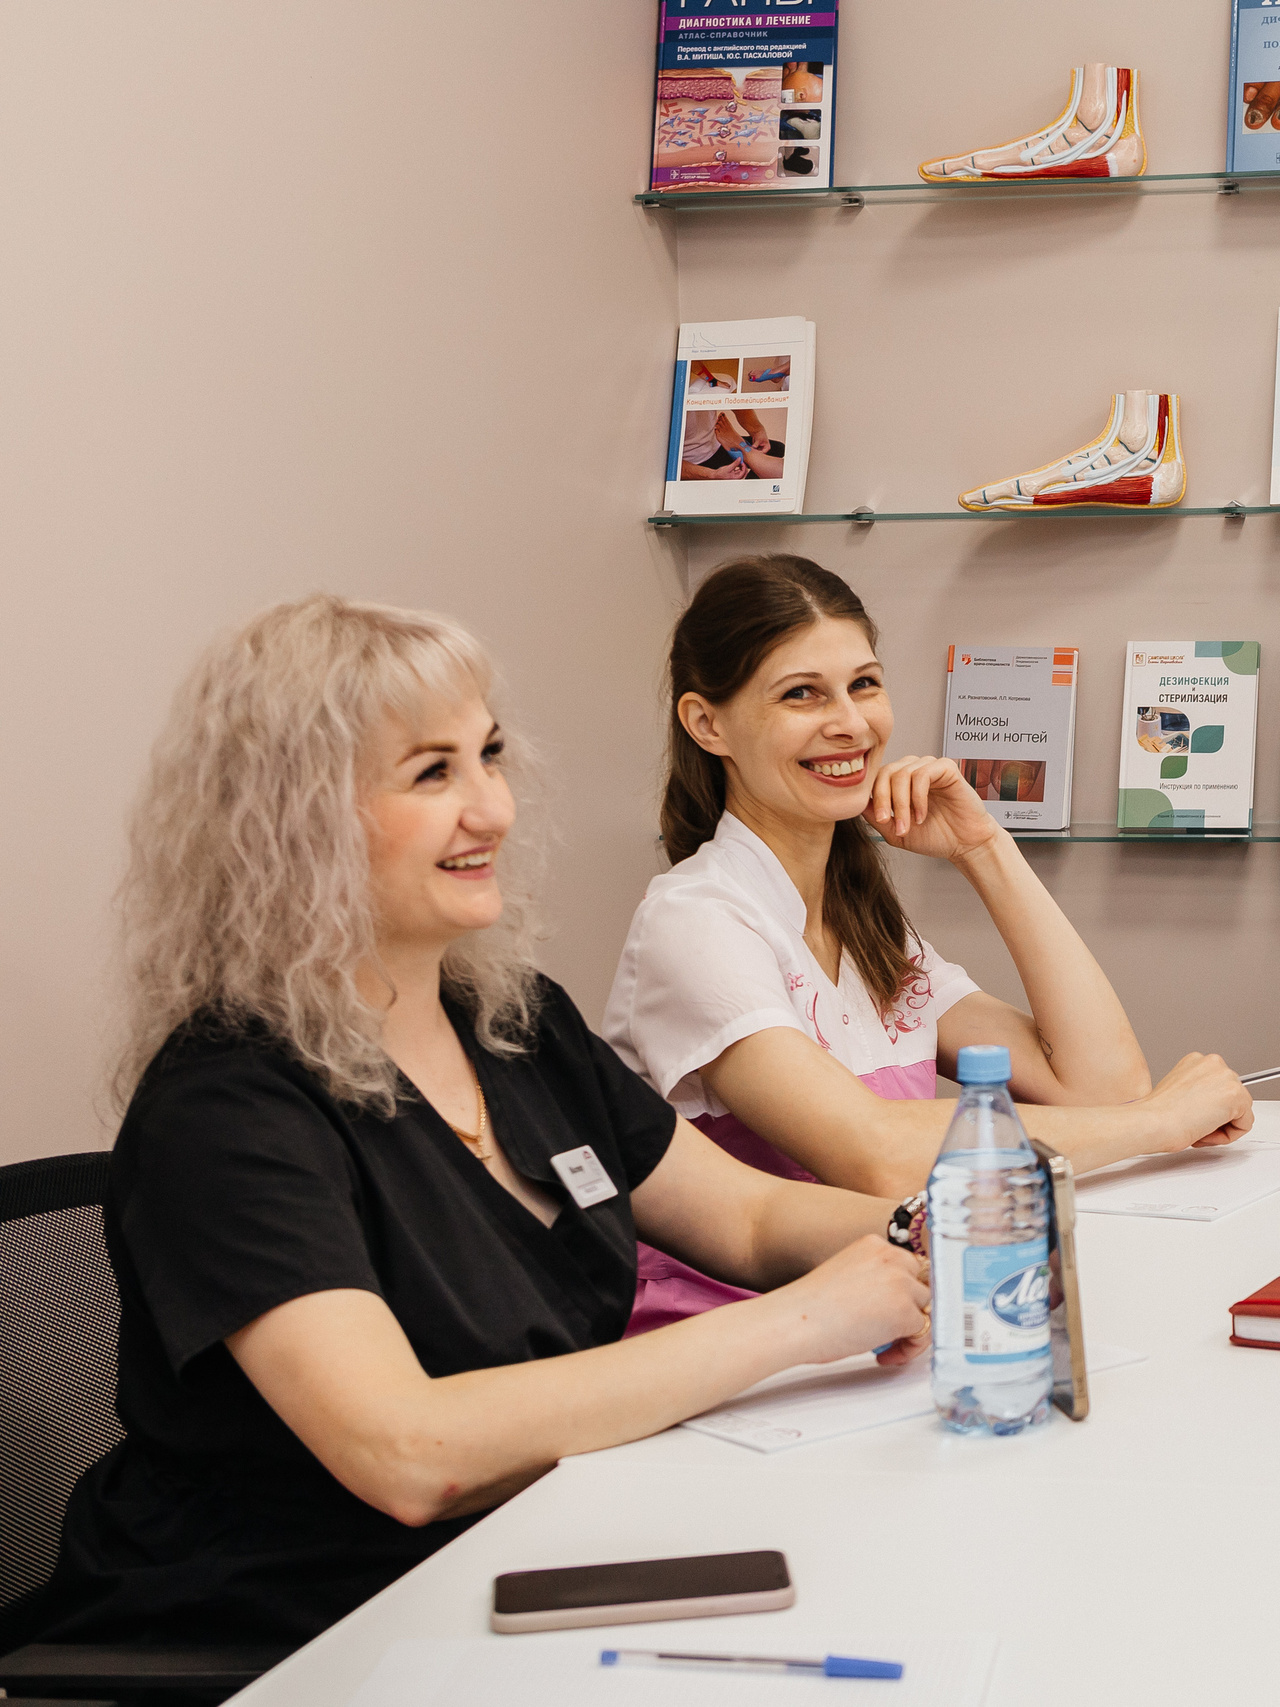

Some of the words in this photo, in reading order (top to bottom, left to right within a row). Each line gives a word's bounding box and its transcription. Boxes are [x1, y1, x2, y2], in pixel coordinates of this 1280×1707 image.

[678, 16, 752, 29] ДИАГНОСТИКА
[755, 16, 762, 26] И
[765, 15, 811, 26] ЛЕЧЕНИЕ
[678, 31, 768, 40] АТЛАС-СПРАВОЧНИК
[677, 45, 706, 53] Перевод
[769, 43, 807, 51] редакцией
[743, 51, 793, 59] ПАСХАЛОВОЙ
[686, 398, 722, 406] Концепция
[1159, 676, 1229, 686] ДЕЗИНФЕКЦИЯ
[1158, 693, 1228, 704] СТЕРИЛИЗАЦИЯ
[956, 713, 1009, 727] Микозы
[955, 731, 988, 741] кожи
[992, 732, 1000, 742] и
[1003, 731, 1048, 743] ногтей
[1159, 783, 1192, 791] Инструкция
